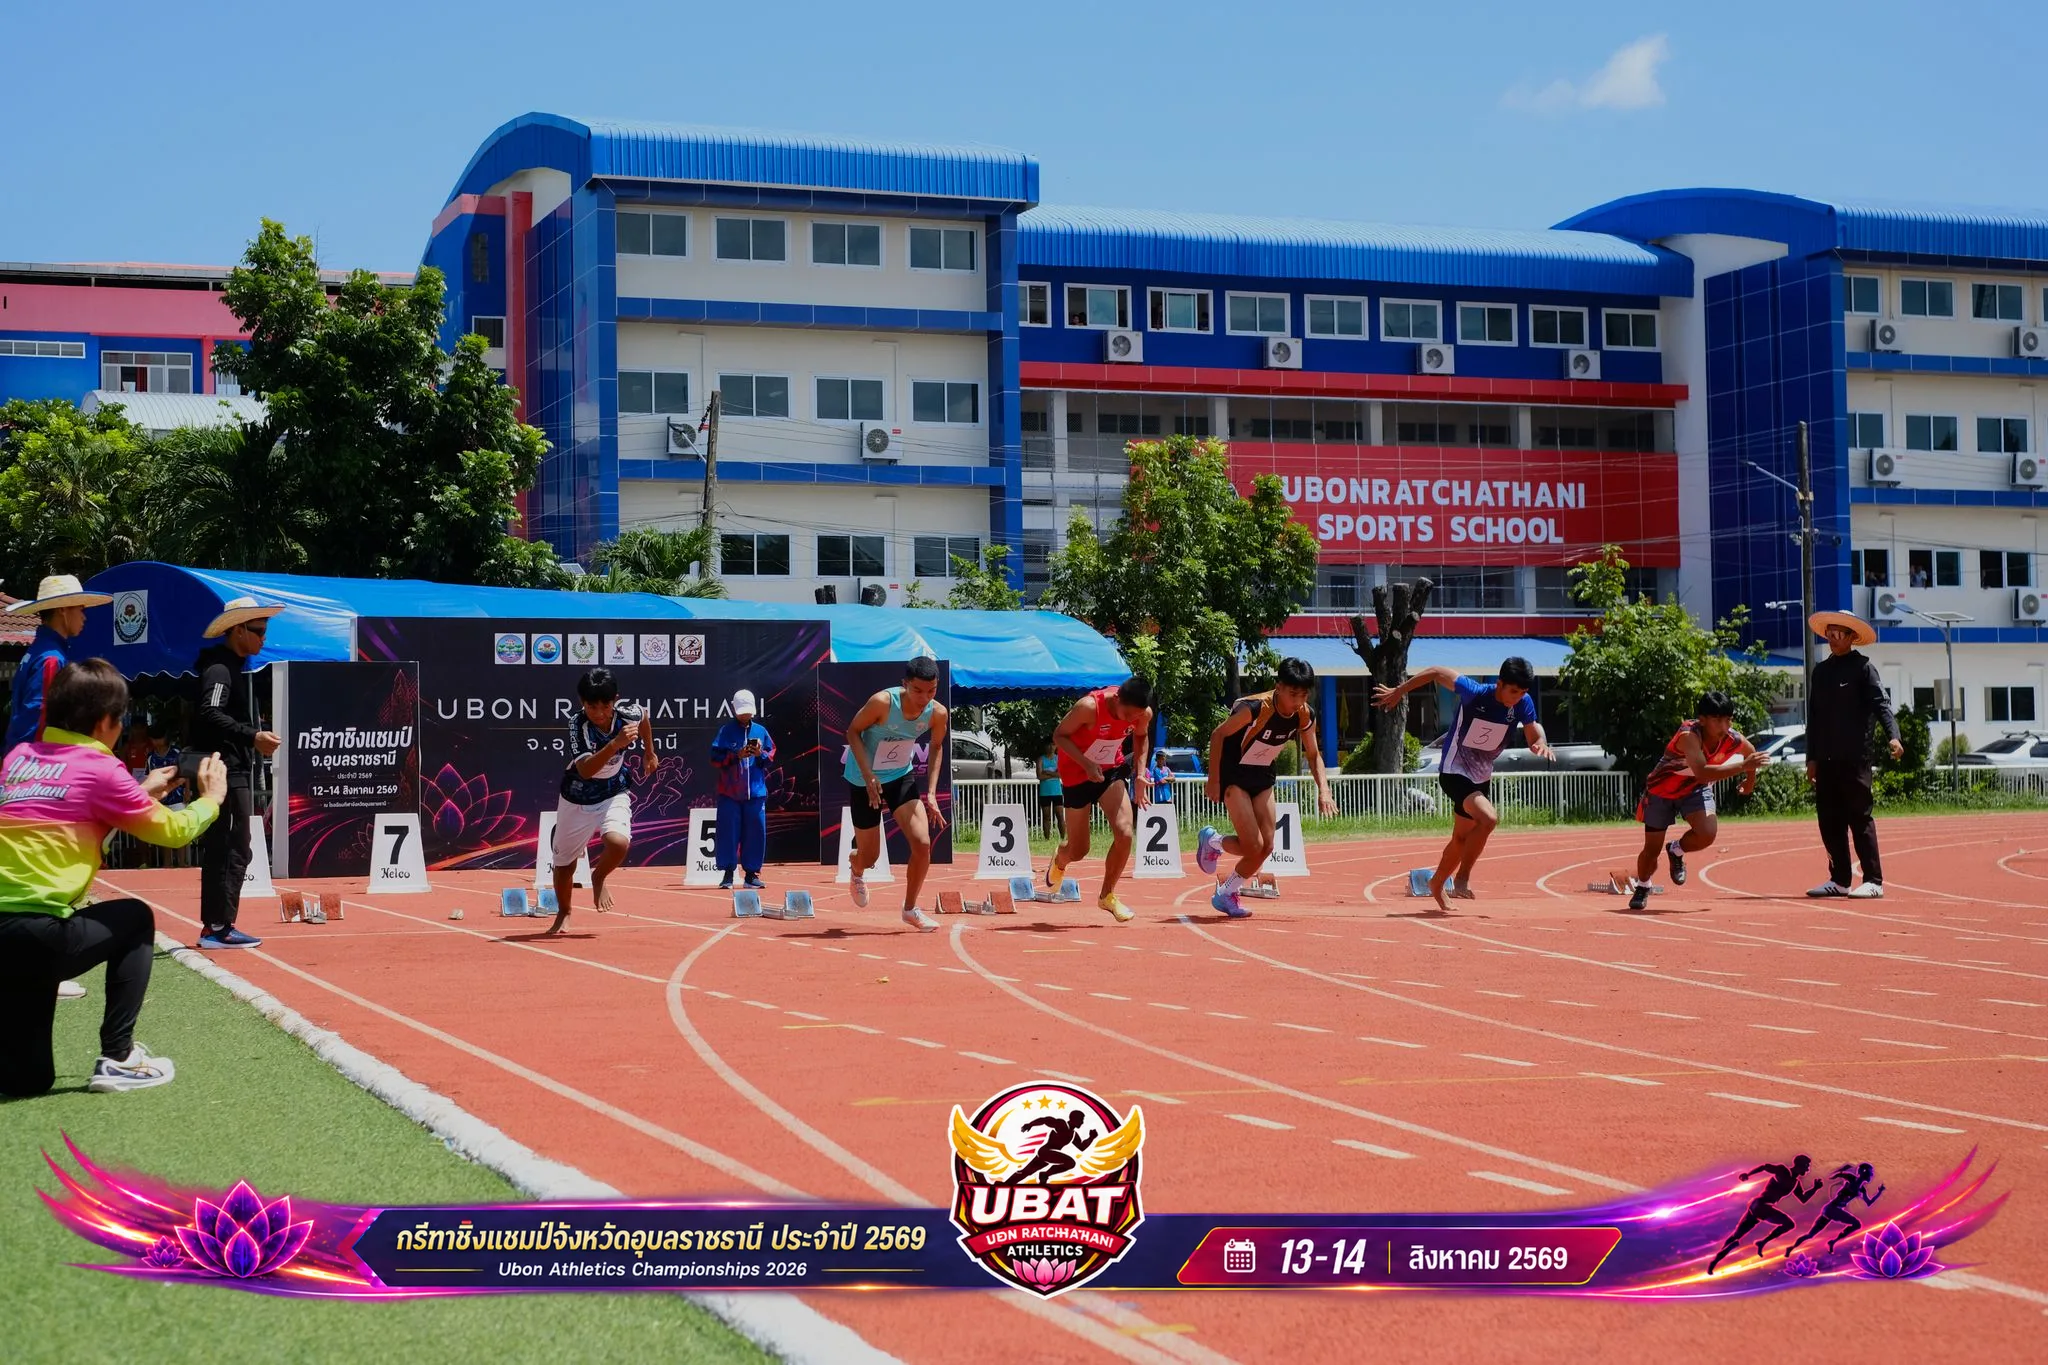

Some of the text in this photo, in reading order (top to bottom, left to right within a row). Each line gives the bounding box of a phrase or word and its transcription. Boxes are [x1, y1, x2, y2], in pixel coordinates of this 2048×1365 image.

[1282, 475, 1585, 509] UBONRATCHATHANI
[1318, 513, 1564, 544] SPORTS SCHOOL
[437, 698, 537, 720] UBON
[1472, 727, 1493, 745] 3
[311, 749, 397, 771] จ.อุบลราชธานี
[886, 744, 900, 760] 6
[1094, 744, 1115, 760] 5
[342, 784, 374, 795] สิงหาคม
[376, 784, 398, 794] 2569
[699, 820, 717, 858] 5
[991, 815, 1015, 854] 3
[1145, 815, 1169, 852] 2
[1275, 813, 1291, 851] 1
[383, 825, 410, 865] 7
[695, 860, 718, 872] Nelc
[987, 855, 1016, 867] Nelco
[1142, 855, 1170, 866] Nelco
[1269, 851, 1295, 863] Nelco
[380, 867, 411, 879] Nelco
